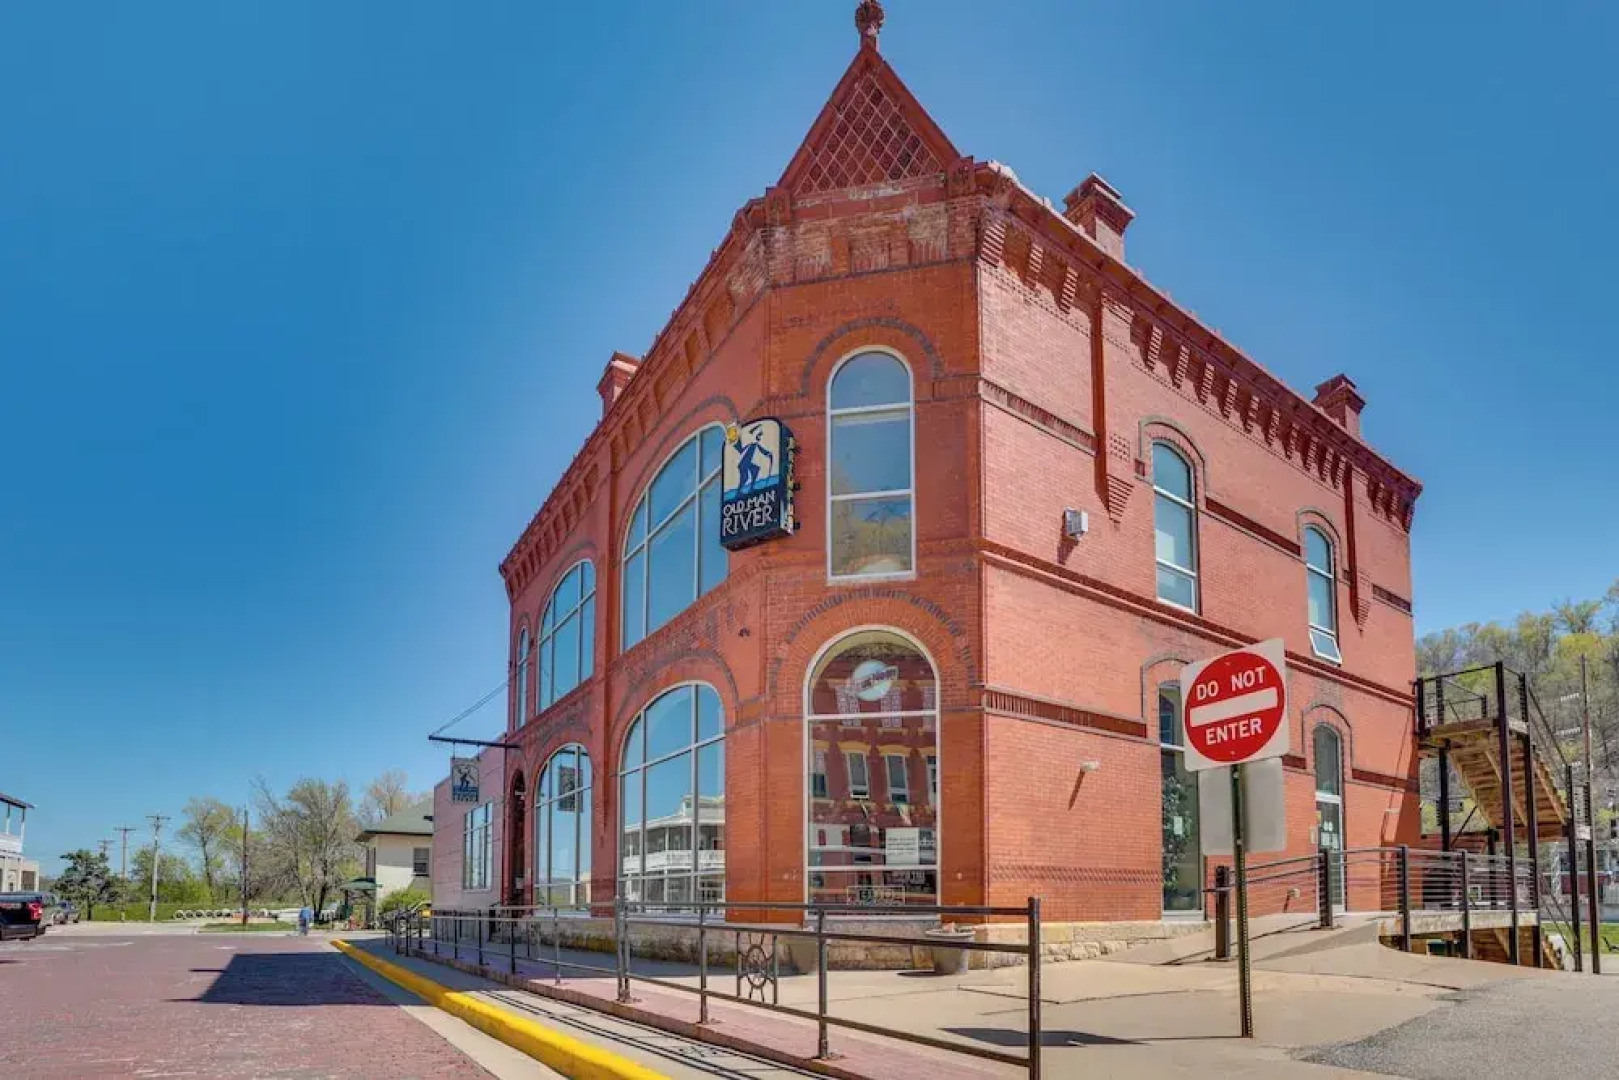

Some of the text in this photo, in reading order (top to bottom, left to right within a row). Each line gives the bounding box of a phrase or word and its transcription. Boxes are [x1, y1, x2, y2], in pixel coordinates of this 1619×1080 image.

[723, 490, 776, 517] OLD MAN
[723, 504, 773, 537] RIVER
[1196, 666, 1266, 701] DO NOT
[1205, 718, 1262, 746] ENTER
